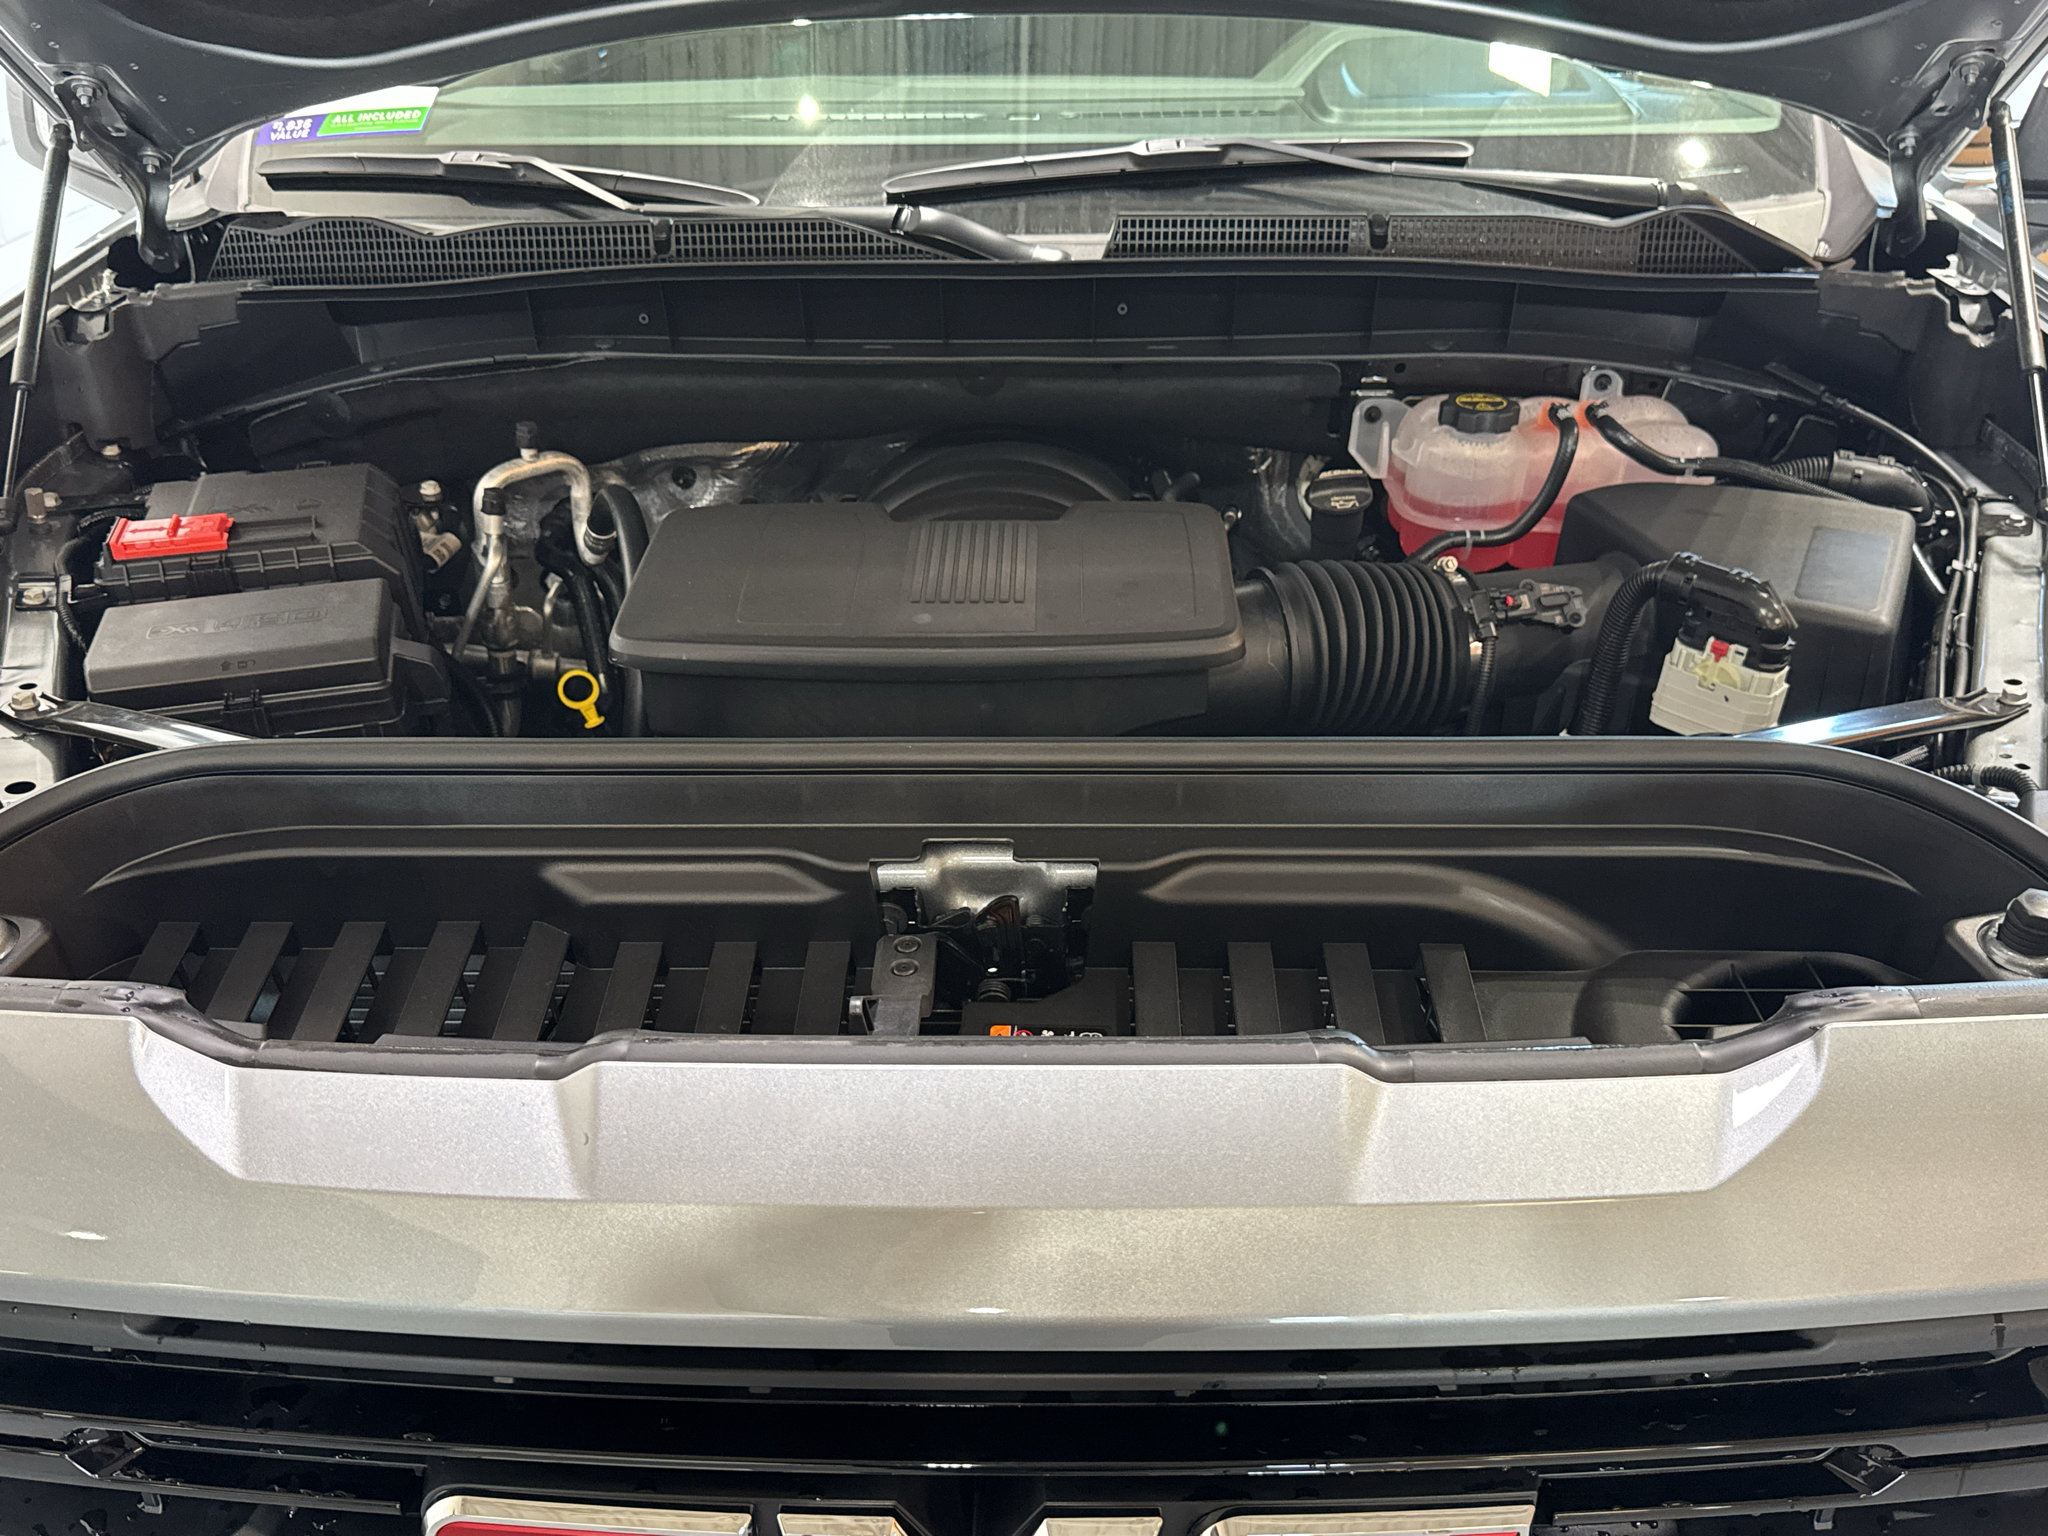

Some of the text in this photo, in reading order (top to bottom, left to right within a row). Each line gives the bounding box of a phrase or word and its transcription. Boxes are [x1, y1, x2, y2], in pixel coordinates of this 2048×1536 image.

[332, 115, 354, 124] ALL
[357, 110, 421, 122] INCLUDED
[270, 128, 310, 141] VALUE
